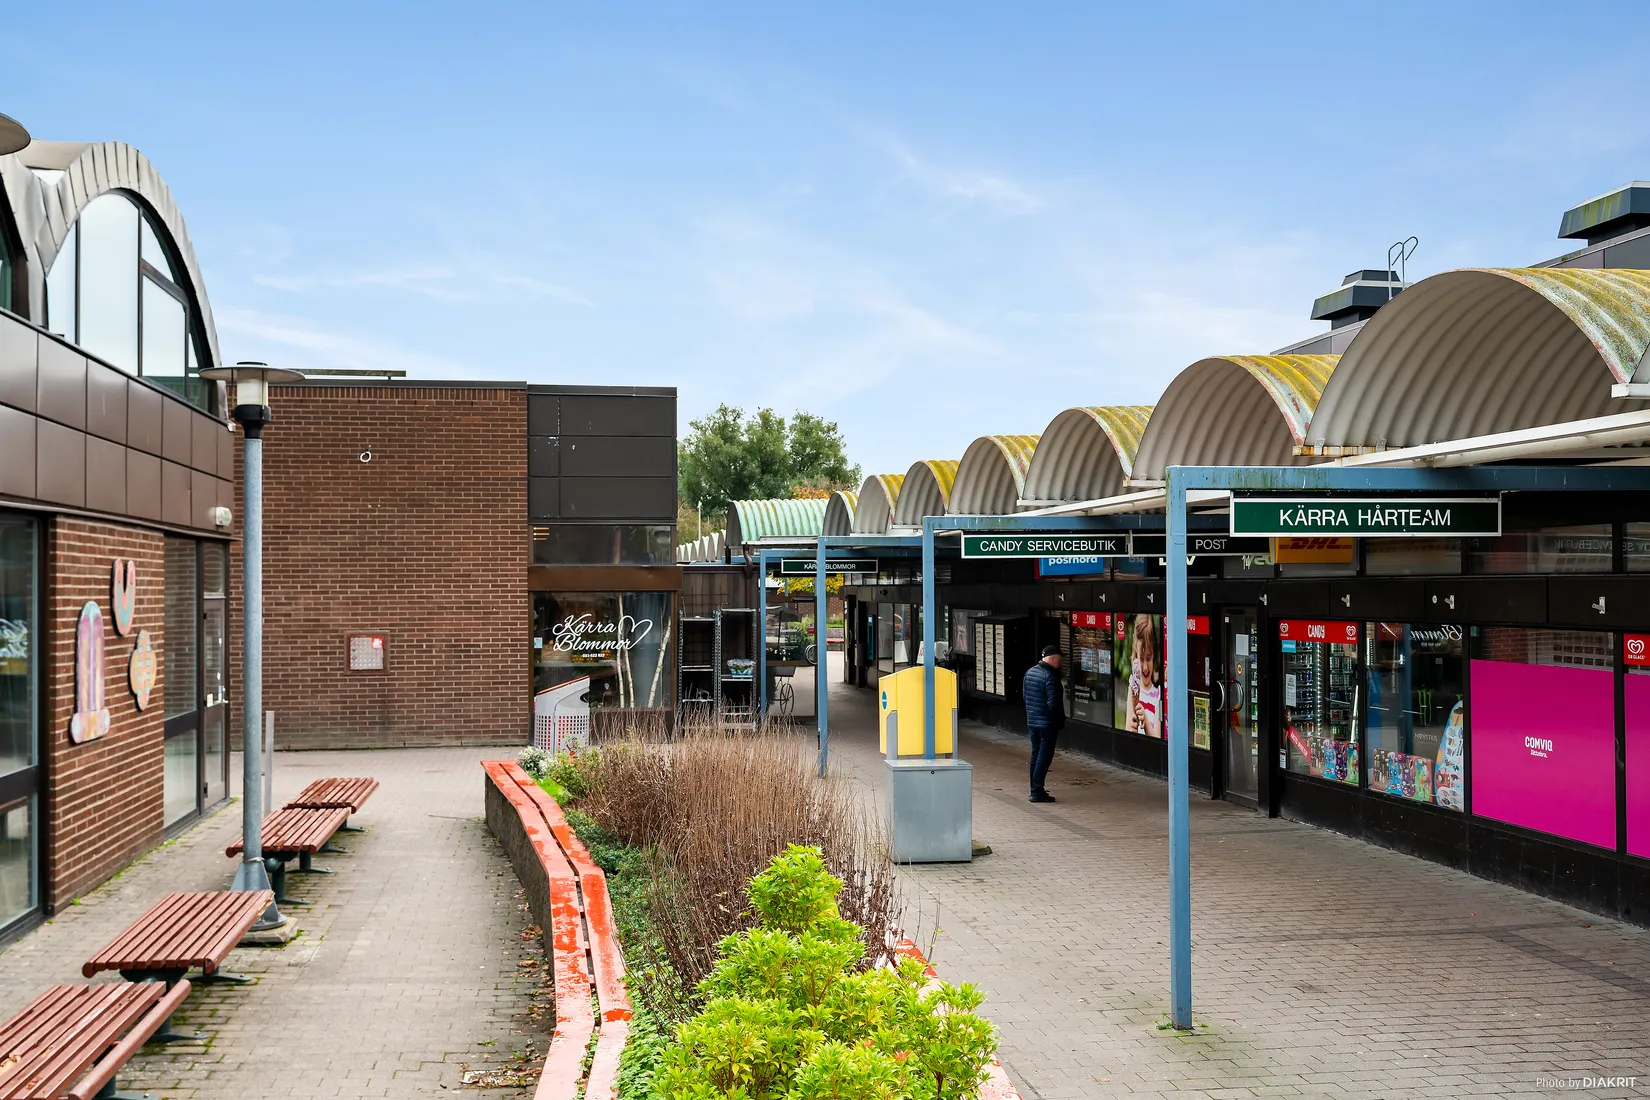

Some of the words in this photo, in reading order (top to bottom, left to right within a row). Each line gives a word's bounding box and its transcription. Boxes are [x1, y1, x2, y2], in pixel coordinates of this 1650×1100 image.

[1279, 504, 1349, 526] KÄRRA
[1358, 504, 1451, 526] HÅRTEAM
[980, 540, 1023, 552] CANDY
[1027, 540, 1117, 552] SERVICEBUTIK
[1195, 539, 1228, 550] POST
[1289, 537, 1341, 550] DHL
[803, 562, 818, 570] KÄR
[552, 613, 617, 636] Kärra
[1307, 624, 1325, 639] CANDY
[553, 632, 633, 652] Blommor
[1524, 735, 1553, 752] COMVIQ
